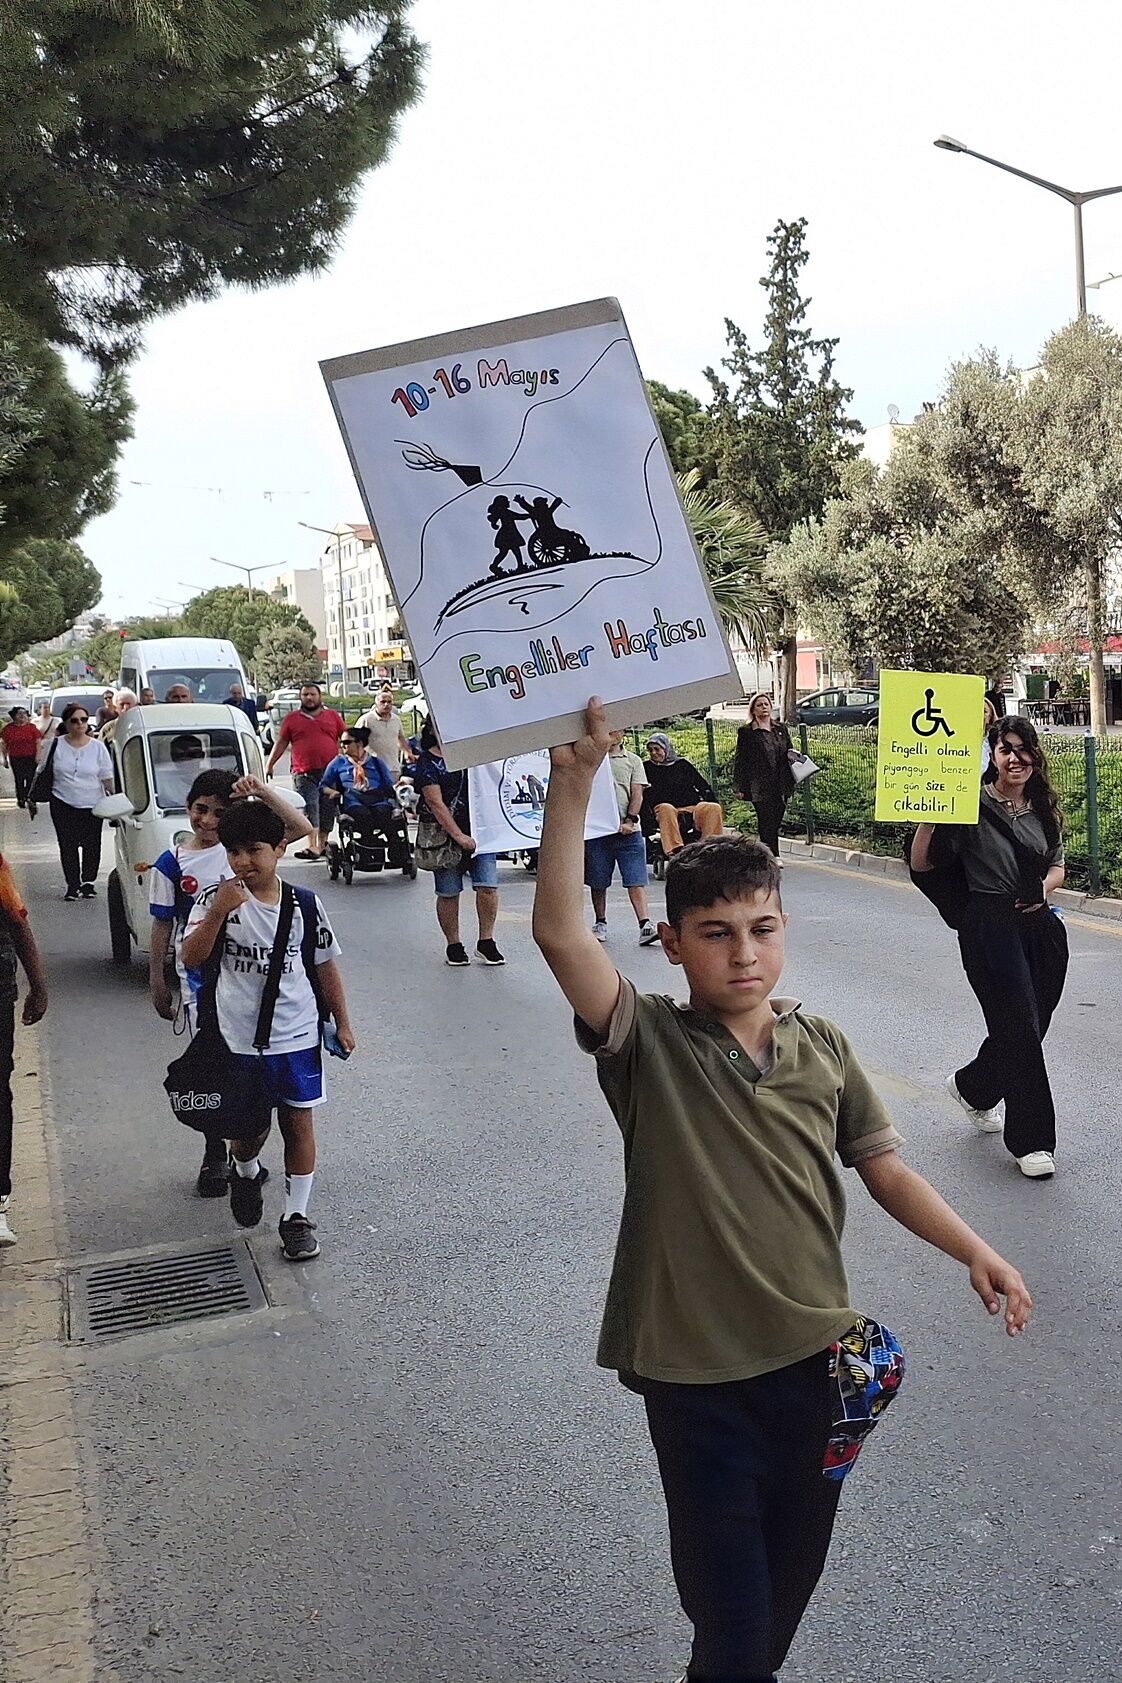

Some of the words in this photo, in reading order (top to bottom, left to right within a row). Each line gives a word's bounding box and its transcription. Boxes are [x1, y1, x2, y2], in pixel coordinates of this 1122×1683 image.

[390, 364, 472, 418] 10-16
[477, 359, 560, 397] Mayıs
[459, 635, 595, 700] Engelliler
[604, 607, 708, 662] Haftası
[891, 741, 928, 758] Engelli
[937, 743, 970, 757] olmak
[941, 761, 973, 775] benzer
[884, 776, 897, 790] bir
[903, 781, 920, 794] gün
[956, 781, 968, 793] de
[317, 931, 330, 949] hp
[234, 960, 253, 974] FLY
